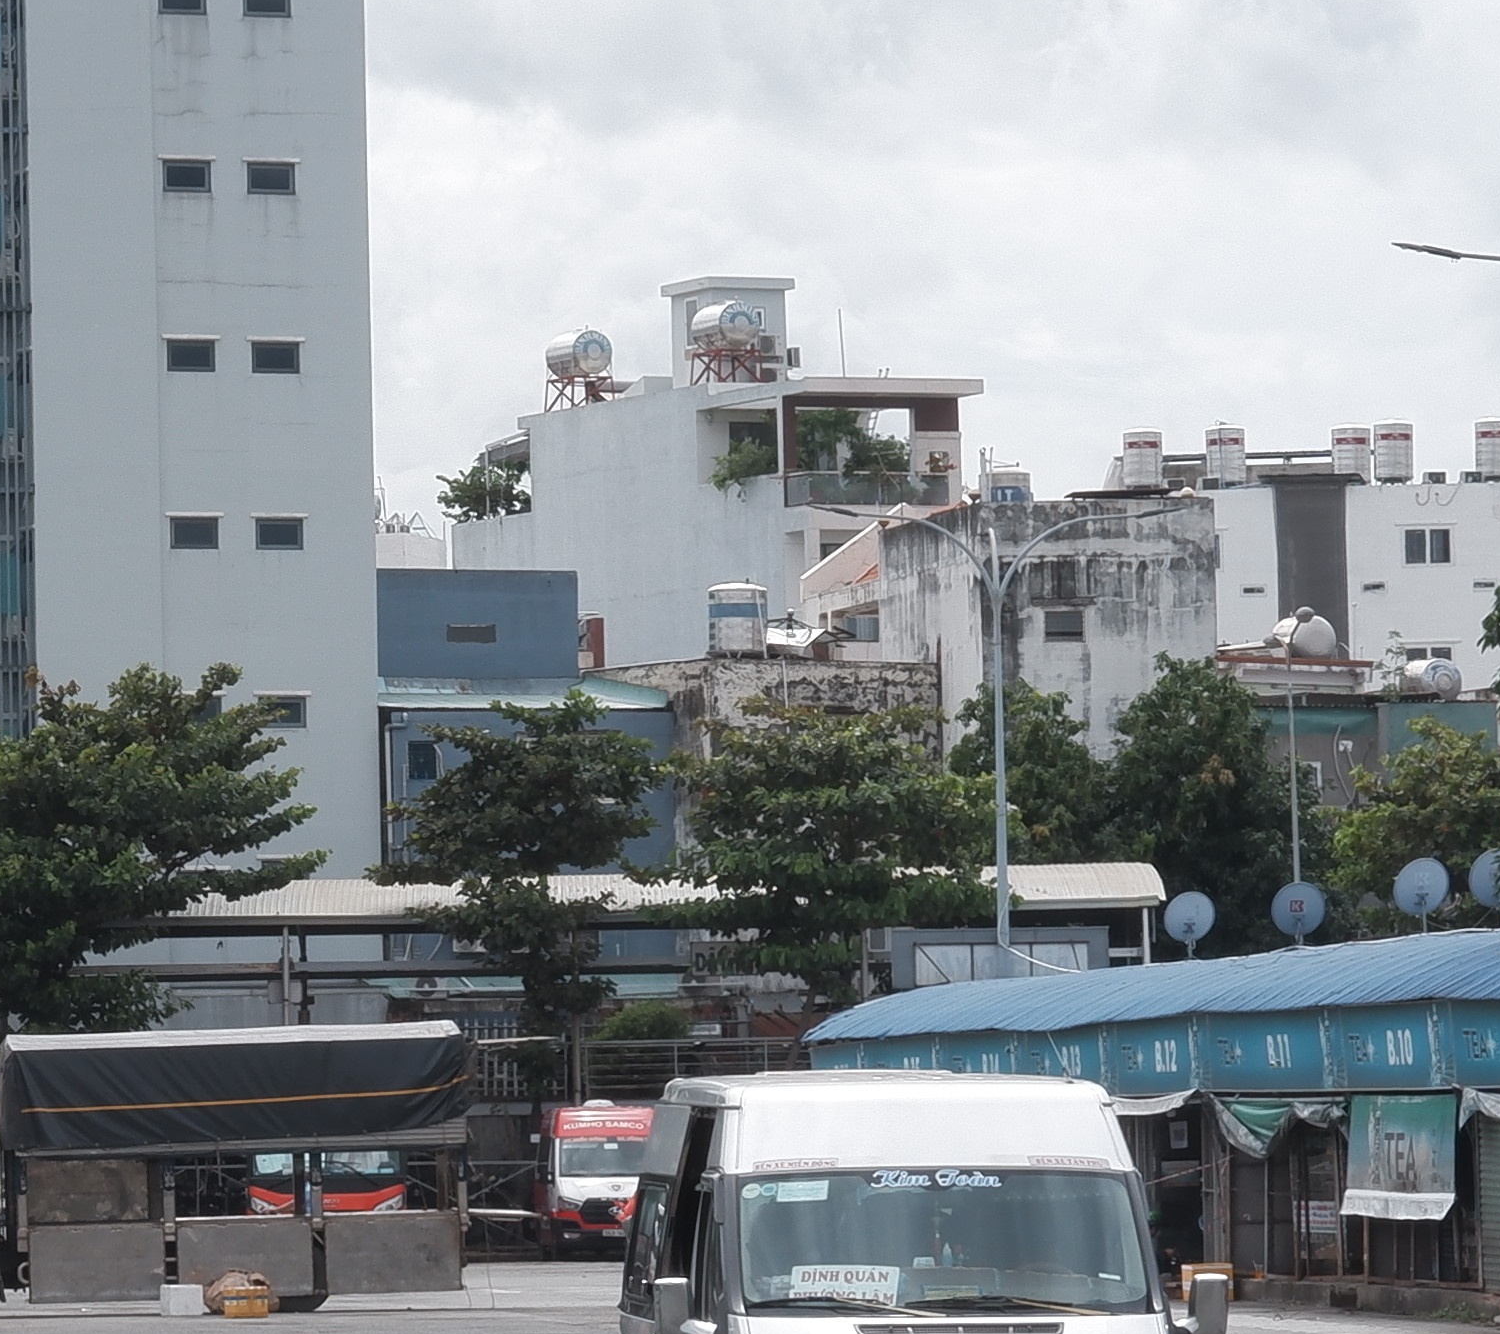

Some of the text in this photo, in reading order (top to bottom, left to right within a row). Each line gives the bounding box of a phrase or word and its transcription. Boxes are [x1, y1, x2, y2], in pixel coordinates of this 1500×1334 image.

[1154, 1039, 1178, 1073] B.12
[1266, 1033, 1292, 1068] B.11
[1386, 1028, 1414, 1066] B.10
[563, 1121, 644, 1130] KUMHO SAMCO
[1384, 1132, 1418, 1181] TEA
[871, 1168, 1002, 1187] Kim Toàn
[844, 1267, 889, 1283] QUÁN
